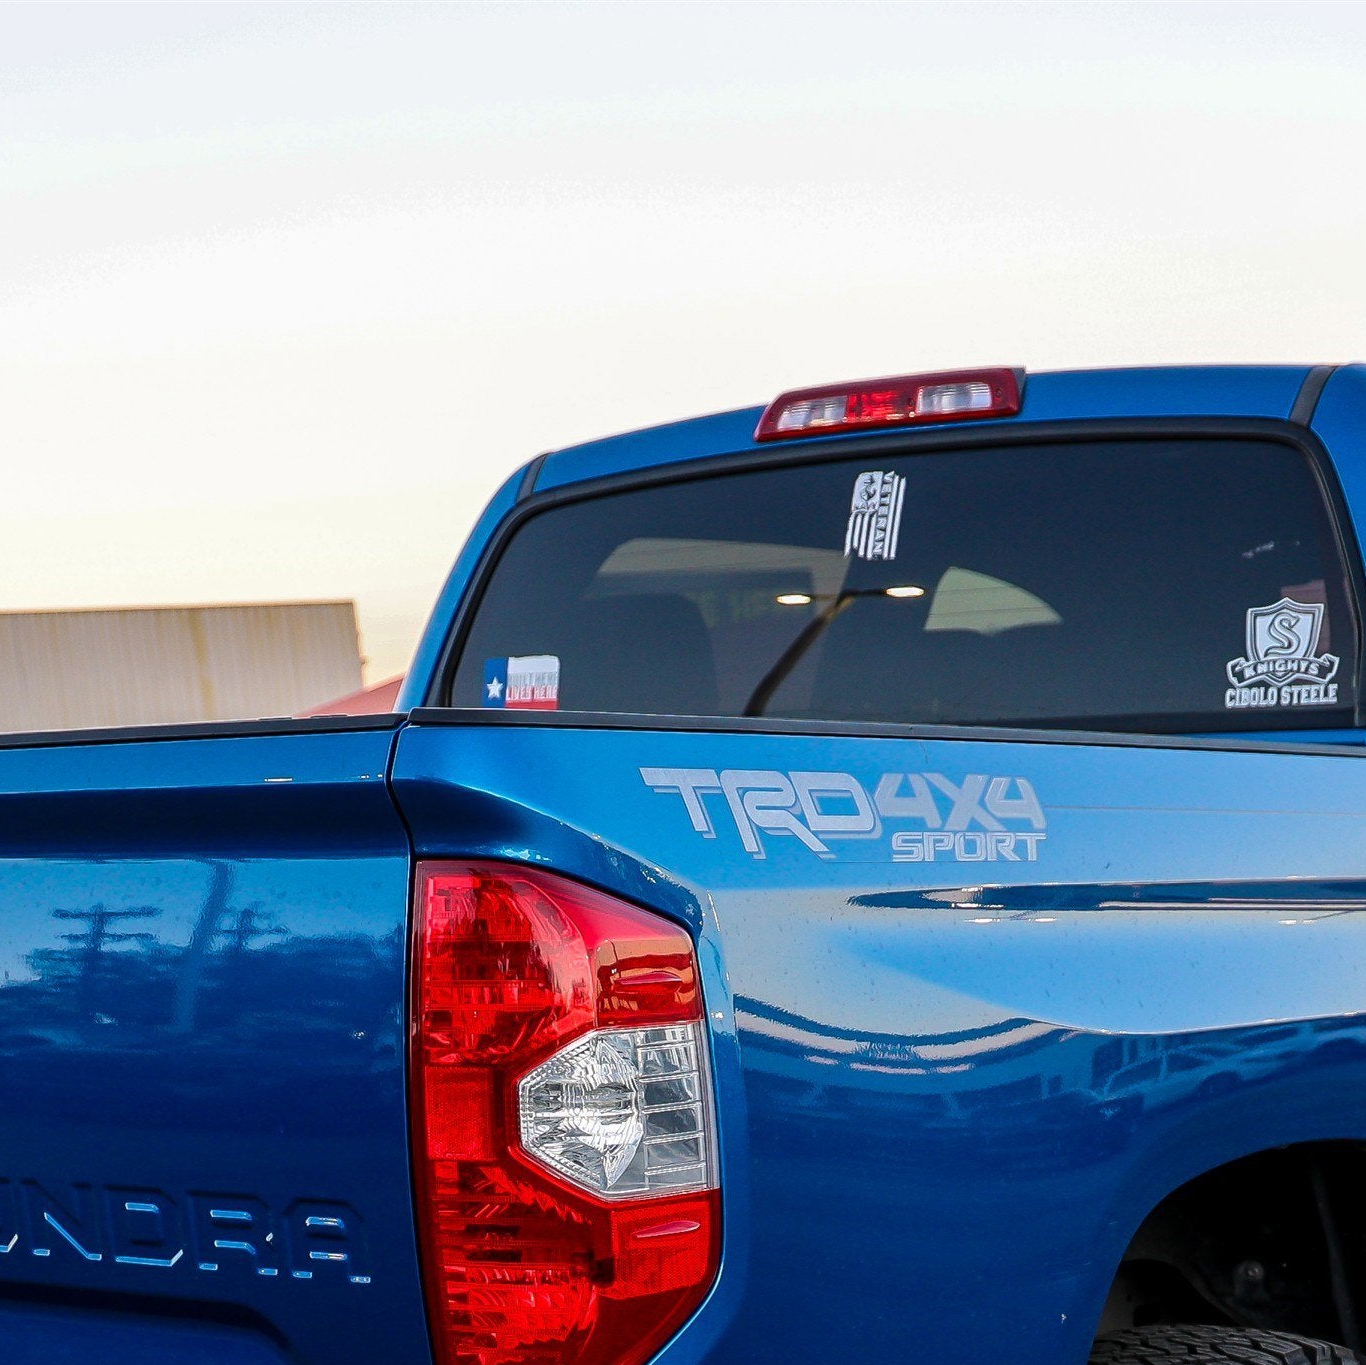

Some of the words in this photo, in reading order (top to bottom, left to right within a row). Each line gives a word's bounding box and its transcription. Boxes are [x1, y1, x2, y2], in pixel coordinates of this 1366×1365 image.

[874, 471, 894, 554] VETERAN
[1225, 686, 1278, 709] CIBOLO
[1280, 684, 1338, 706] STEELE
[638, 767, 882, 860] TRD
[892, 831, 1046, 861] SPORT
